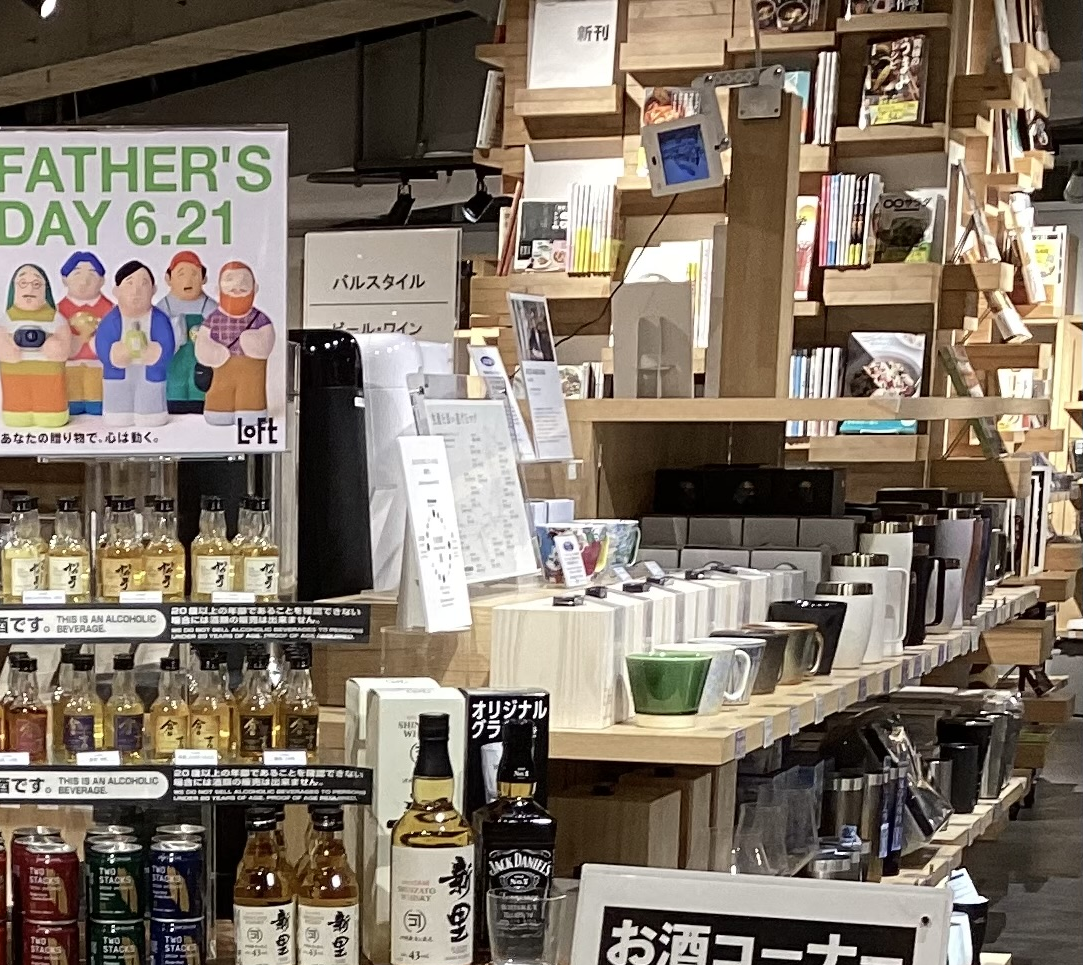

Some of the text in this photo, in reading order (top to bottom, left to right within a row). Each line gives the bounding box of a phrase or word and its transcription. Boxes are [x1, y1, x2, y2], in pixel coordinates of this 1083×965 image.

[577, 24, 609, 41] 新刊
[125, 200, 233, 246] 6.21
[332, 273, 426, 290] バルスタイル
[57, 614, 157, 624] THIS IS AN ALCOHOLIC
[471, 700, 549, 721] オリジナル
[59, 777, 159, 786] THIS IS AN ALCOHOLIC
[152, 866, 167, 874] TWO
[489, 856, 513, 876] JACK
[29, 867, 47, 876] TWO
[99, 867, 116, 875] TWO
[29, 876, 61, 885] STACKS
[99, 876, 131, 884] STACKS
[152, 874, 181, 882] STACKS
[30, 937, 47, 945] TWO
[103, 937, 120, 945] TWO
[165, 936, 182, 944] TWO
[30, 945, 62, 953] STACKS
[103, 945, 135, 953] STACKS
[165, 944, 197, 952] STACKS
